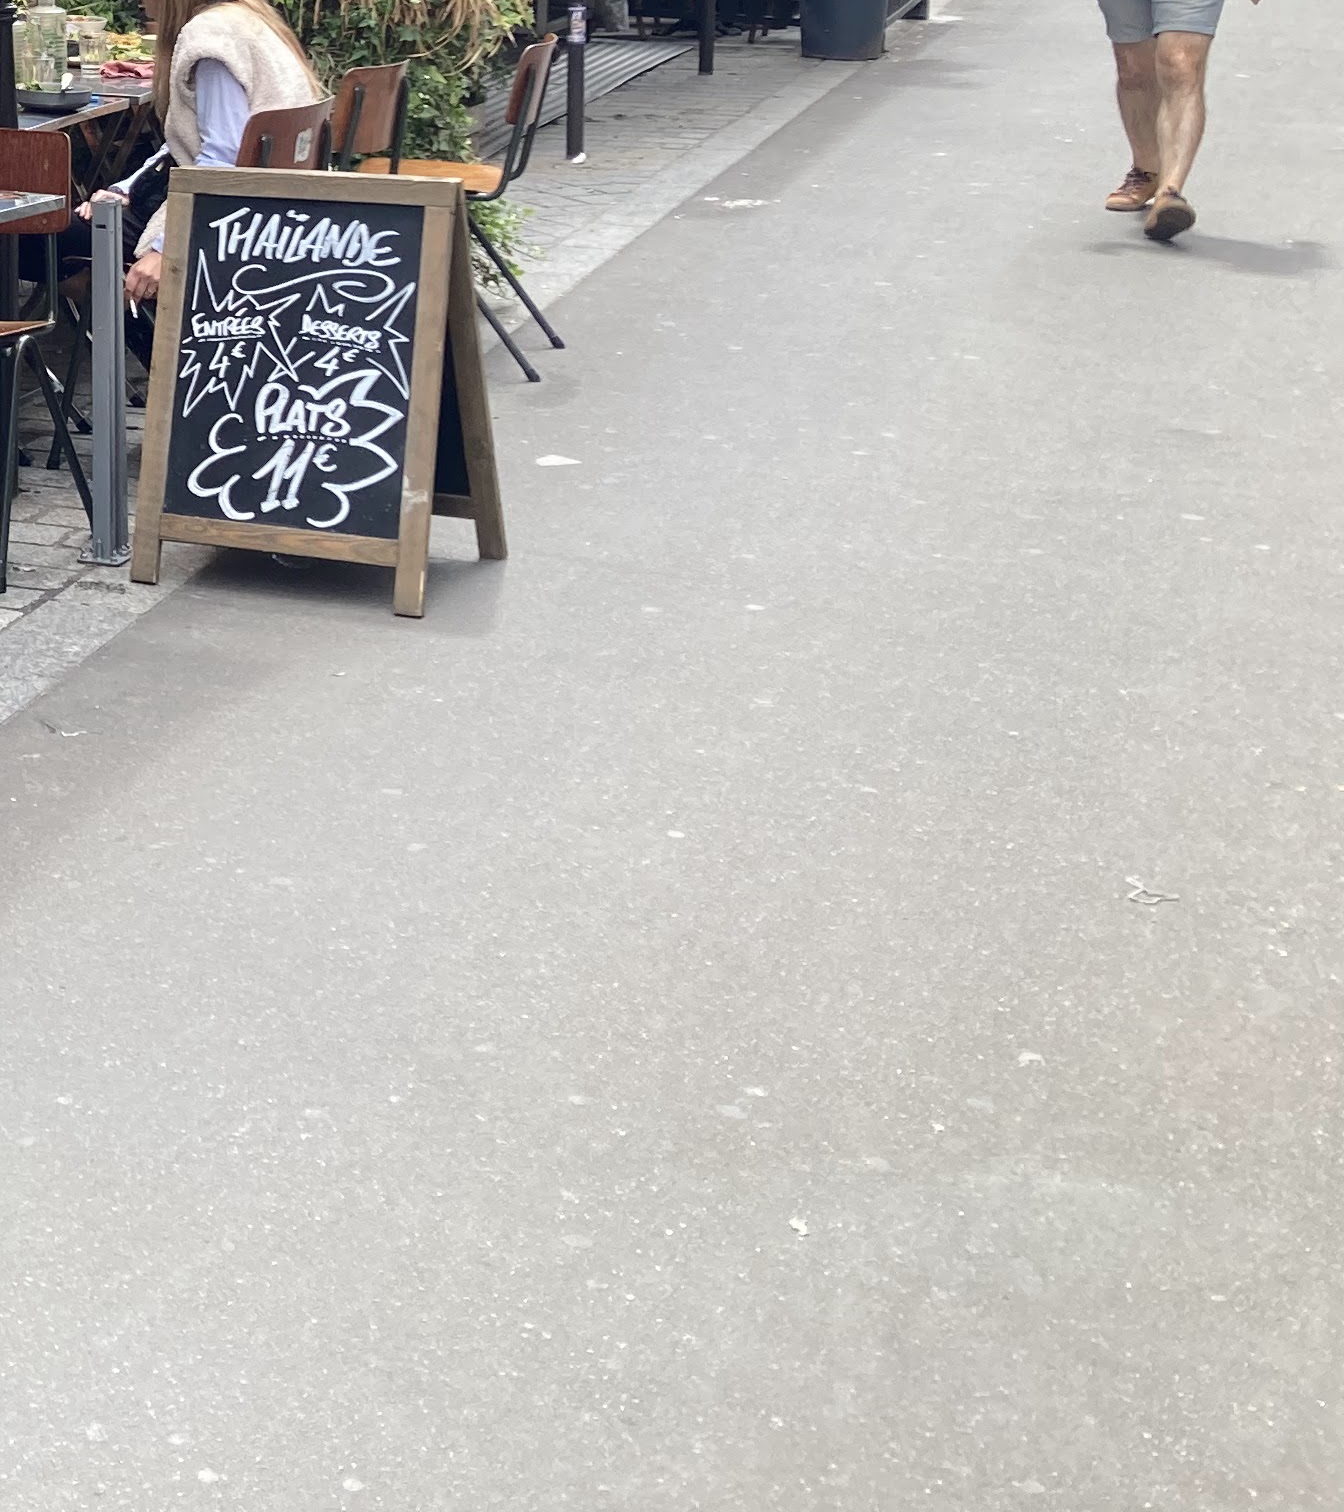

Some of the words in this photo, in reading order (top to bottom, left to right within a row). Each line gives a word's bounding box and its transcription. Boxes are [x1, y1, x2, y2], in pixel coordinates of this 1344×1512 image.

[209, 207, 402, 267] THAÏLANDE
[191, 308, 266, 338] ENTRÉES
[299, 313, 383, 349] DESSERTS
[209, 341, 247, 378] 4€
[313, 346, 359, 377] 4€
[254, 382, 352, 438] PLATS
